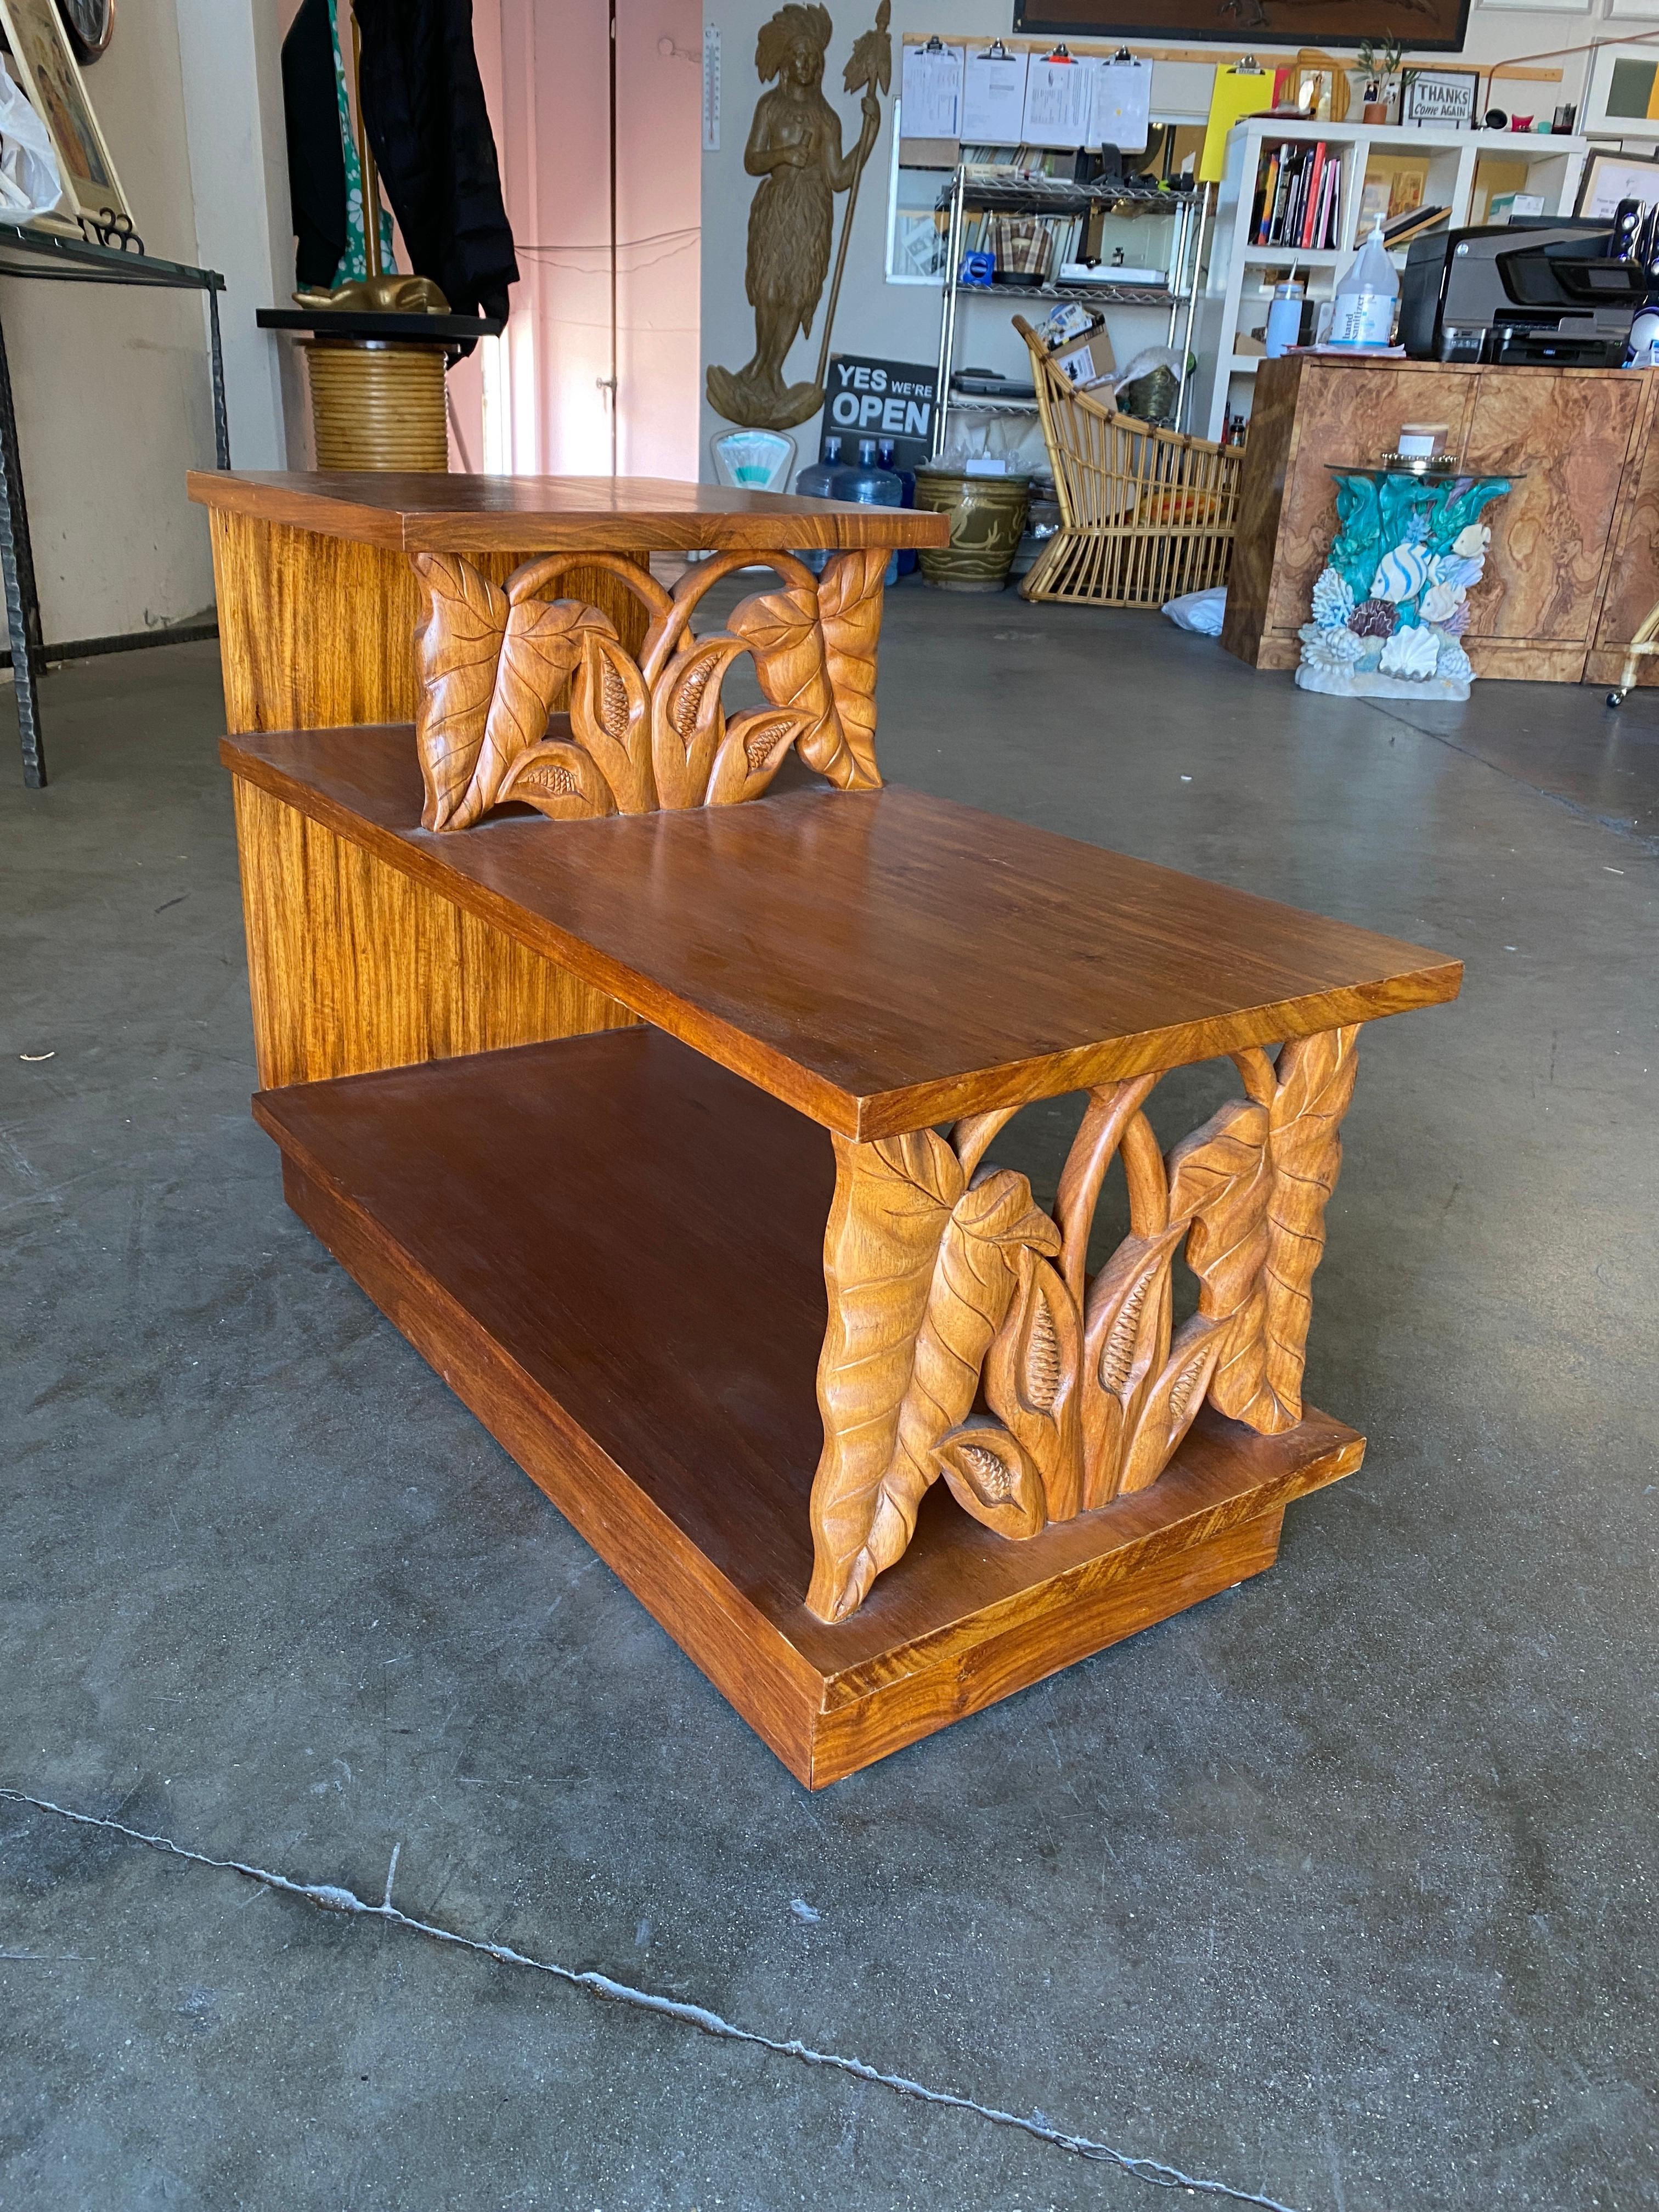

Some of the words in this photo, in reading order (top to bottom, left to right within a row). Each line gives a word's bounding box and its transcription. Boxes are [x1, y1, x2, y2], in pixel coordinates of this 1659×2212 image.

[1418, 83, 1468, 105] THANKS
[1415, 103, 1438, 115] Come
[1441, 104, 1465, 117] AGAIN
[1342, 313, 1353, 339] hand
[1352, 295, 1364, 339] sanitizer
[838, 364, 888, 392] YES
[891, 381, 933, 398] WE'RE
[833, 392, 930, 435] OPEN
